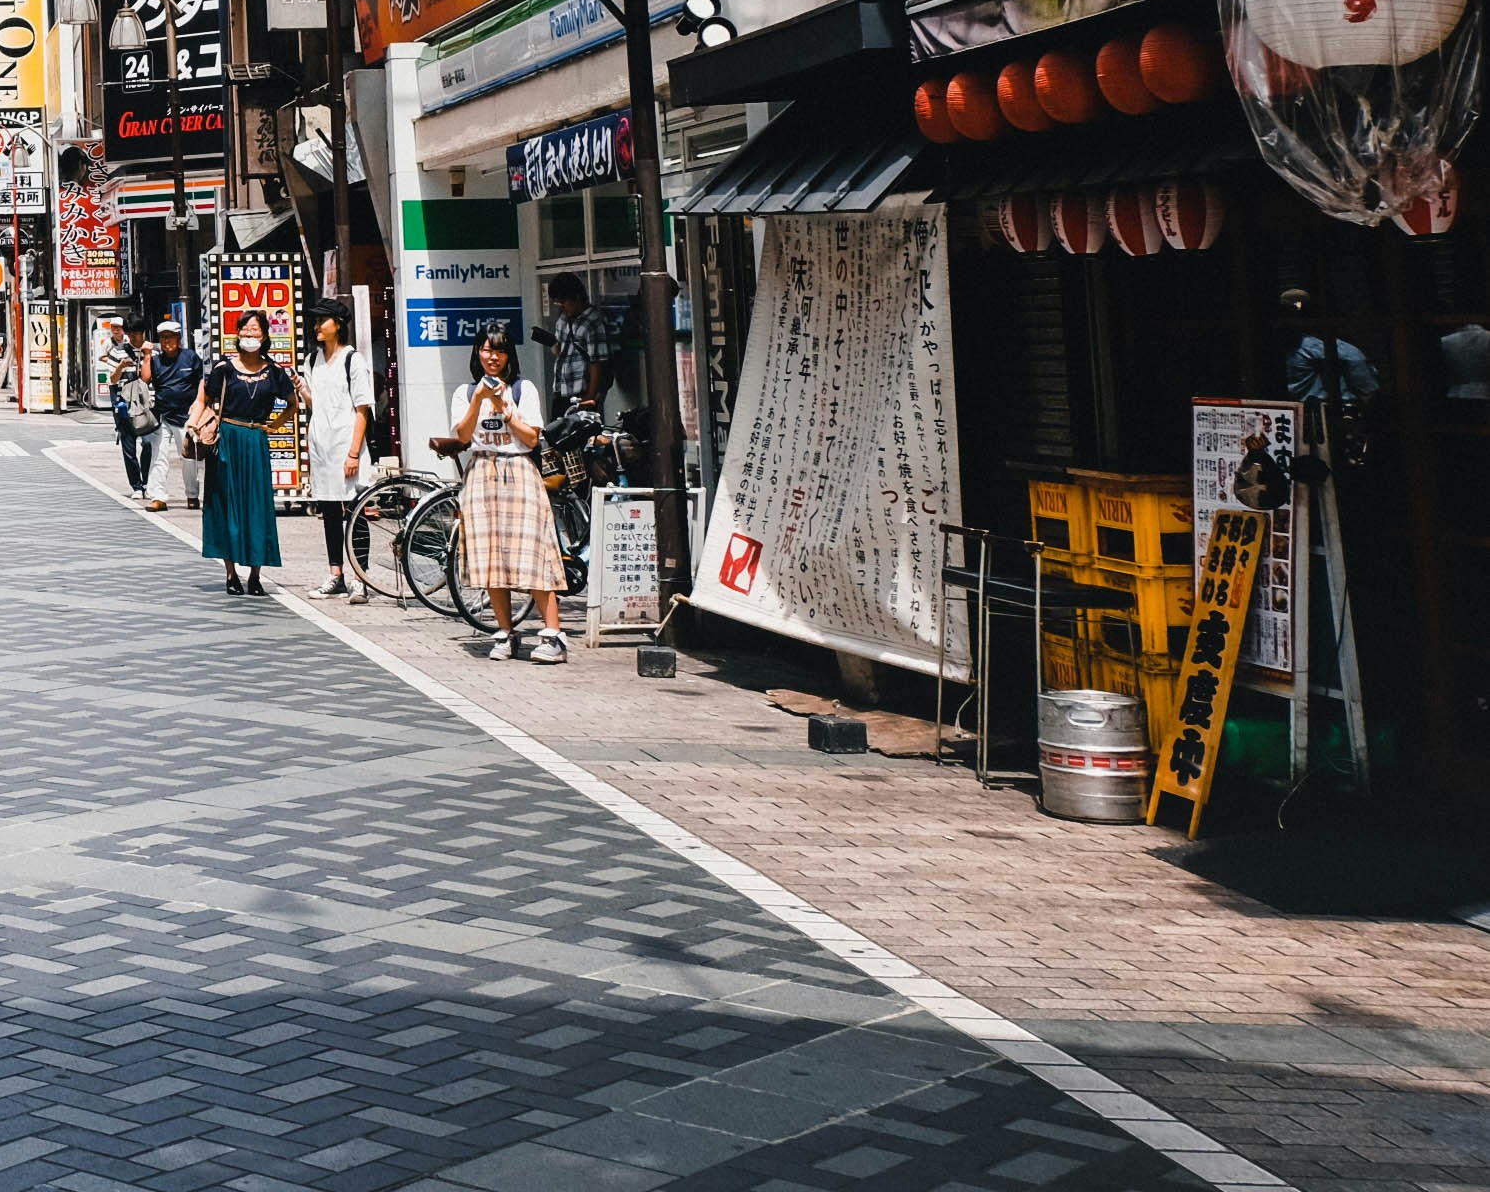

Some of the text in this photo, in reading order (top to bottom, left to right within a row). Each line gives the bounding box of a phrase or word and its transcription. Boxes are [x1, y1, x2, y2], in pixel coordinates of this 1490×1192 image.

[125, 55, 150, 78] 24
[119, 110, 157, 138] GRAN
[60, 180, 89, 266] みみかき
[415, 264, 510, 283] FamilyMart
[222, 282, 290, 308] DVD
[418, 315, 449, 342] 酒
